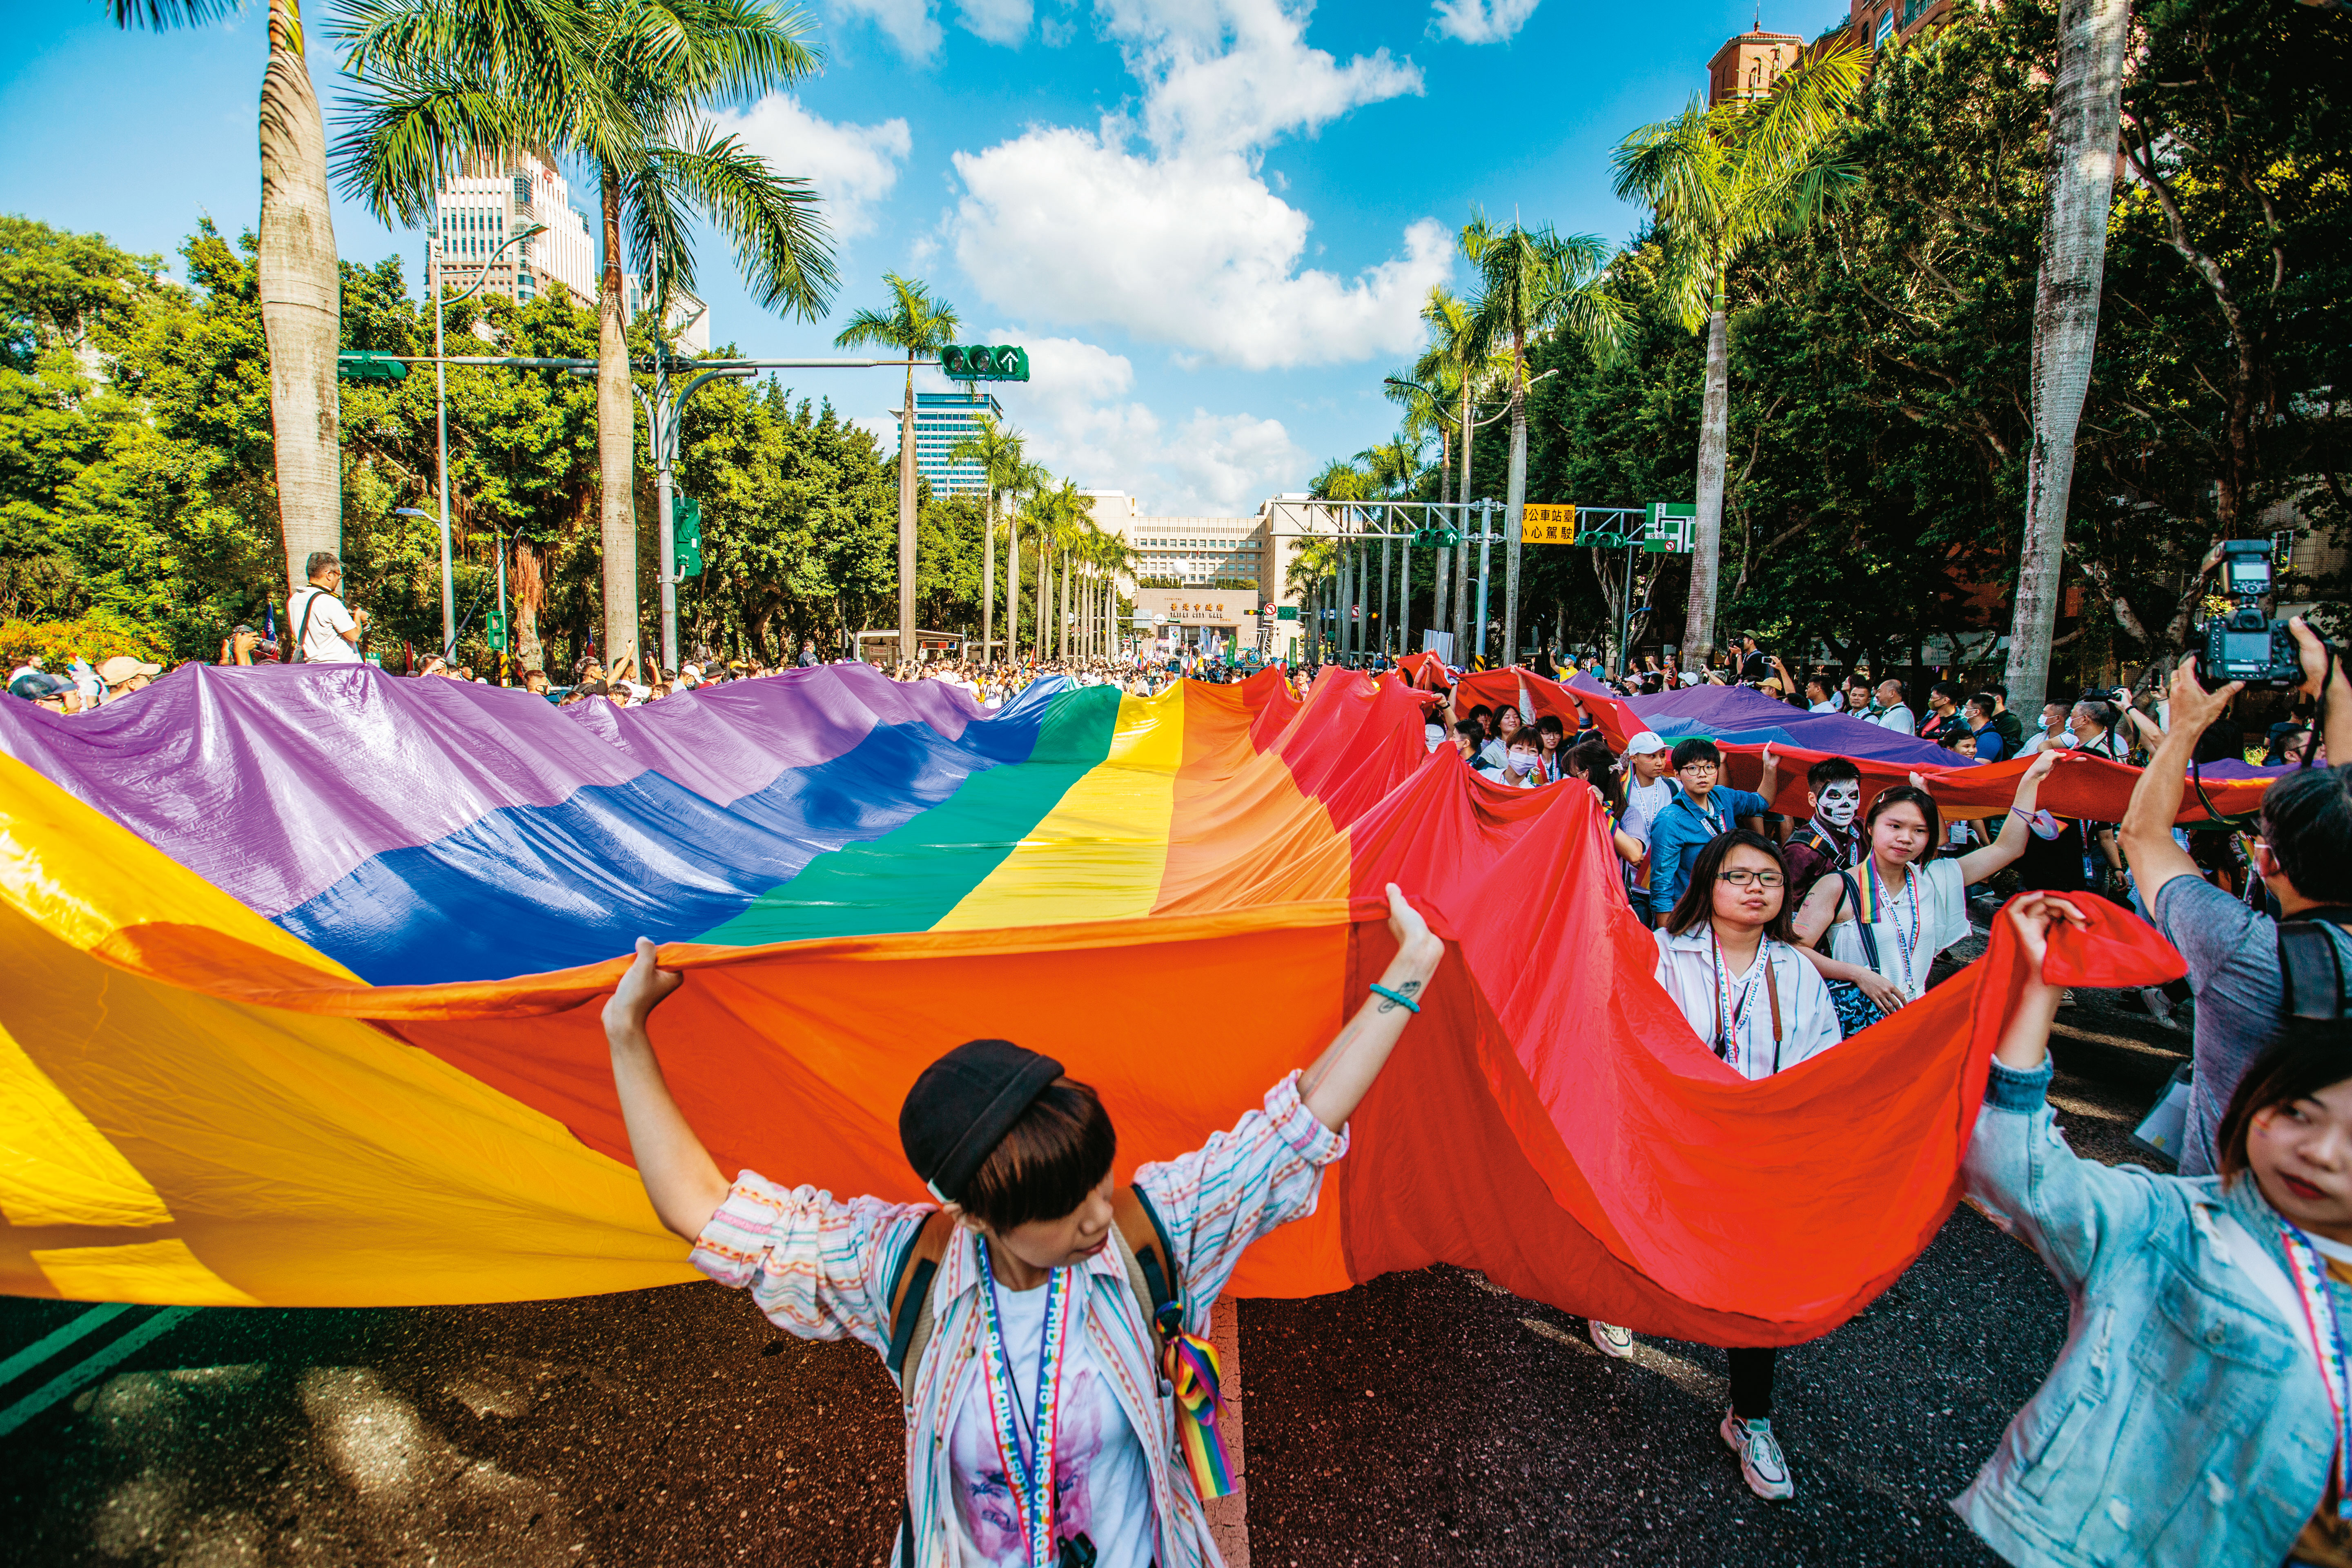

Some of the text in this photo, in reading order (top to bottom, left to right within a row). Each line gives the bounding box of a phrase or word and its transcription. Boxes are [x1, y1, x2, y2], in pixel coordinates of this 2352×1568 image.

[1704, 823, 1716, 837] PRIDE
[1813, 822, 1826, 835] LGBT
[1909, 886, 1917, 908] PRIDE
[1887, 905, 1901, 927] PRIDE
[1897, 928, 1907, 947] LGBT
[1911, 923, 1920, 948] YEARS
[1716, 948, 1727, 976] PRIDE
[1901, 948, 1911, 978] TAIWAN
[1721, 984, 1729, 993] 18
[1736, 938, 1770, 1030] LGBT PRIDE 18 YEAR
[1722, 995, 1733, 1027] YEARS
[1725, 1029, 1734, 1042] OF
[1727, 1043, 1736, 1063] AGE
[1044, 1293, 1067, 1358] PRIDE
[984, 1332, 1001, 1355] 18
[1039, 1382, 1056, 1405] 18
[990, 1376, 1015, 1444] PRIDE
[1034, 1410, 1054, 1485] YEARS
[1002, 1448, 1030, 1494] LGBT
[1034, 1488, 1050, 1518] OF
[1033, 1521, 1050, 1567] AGE
